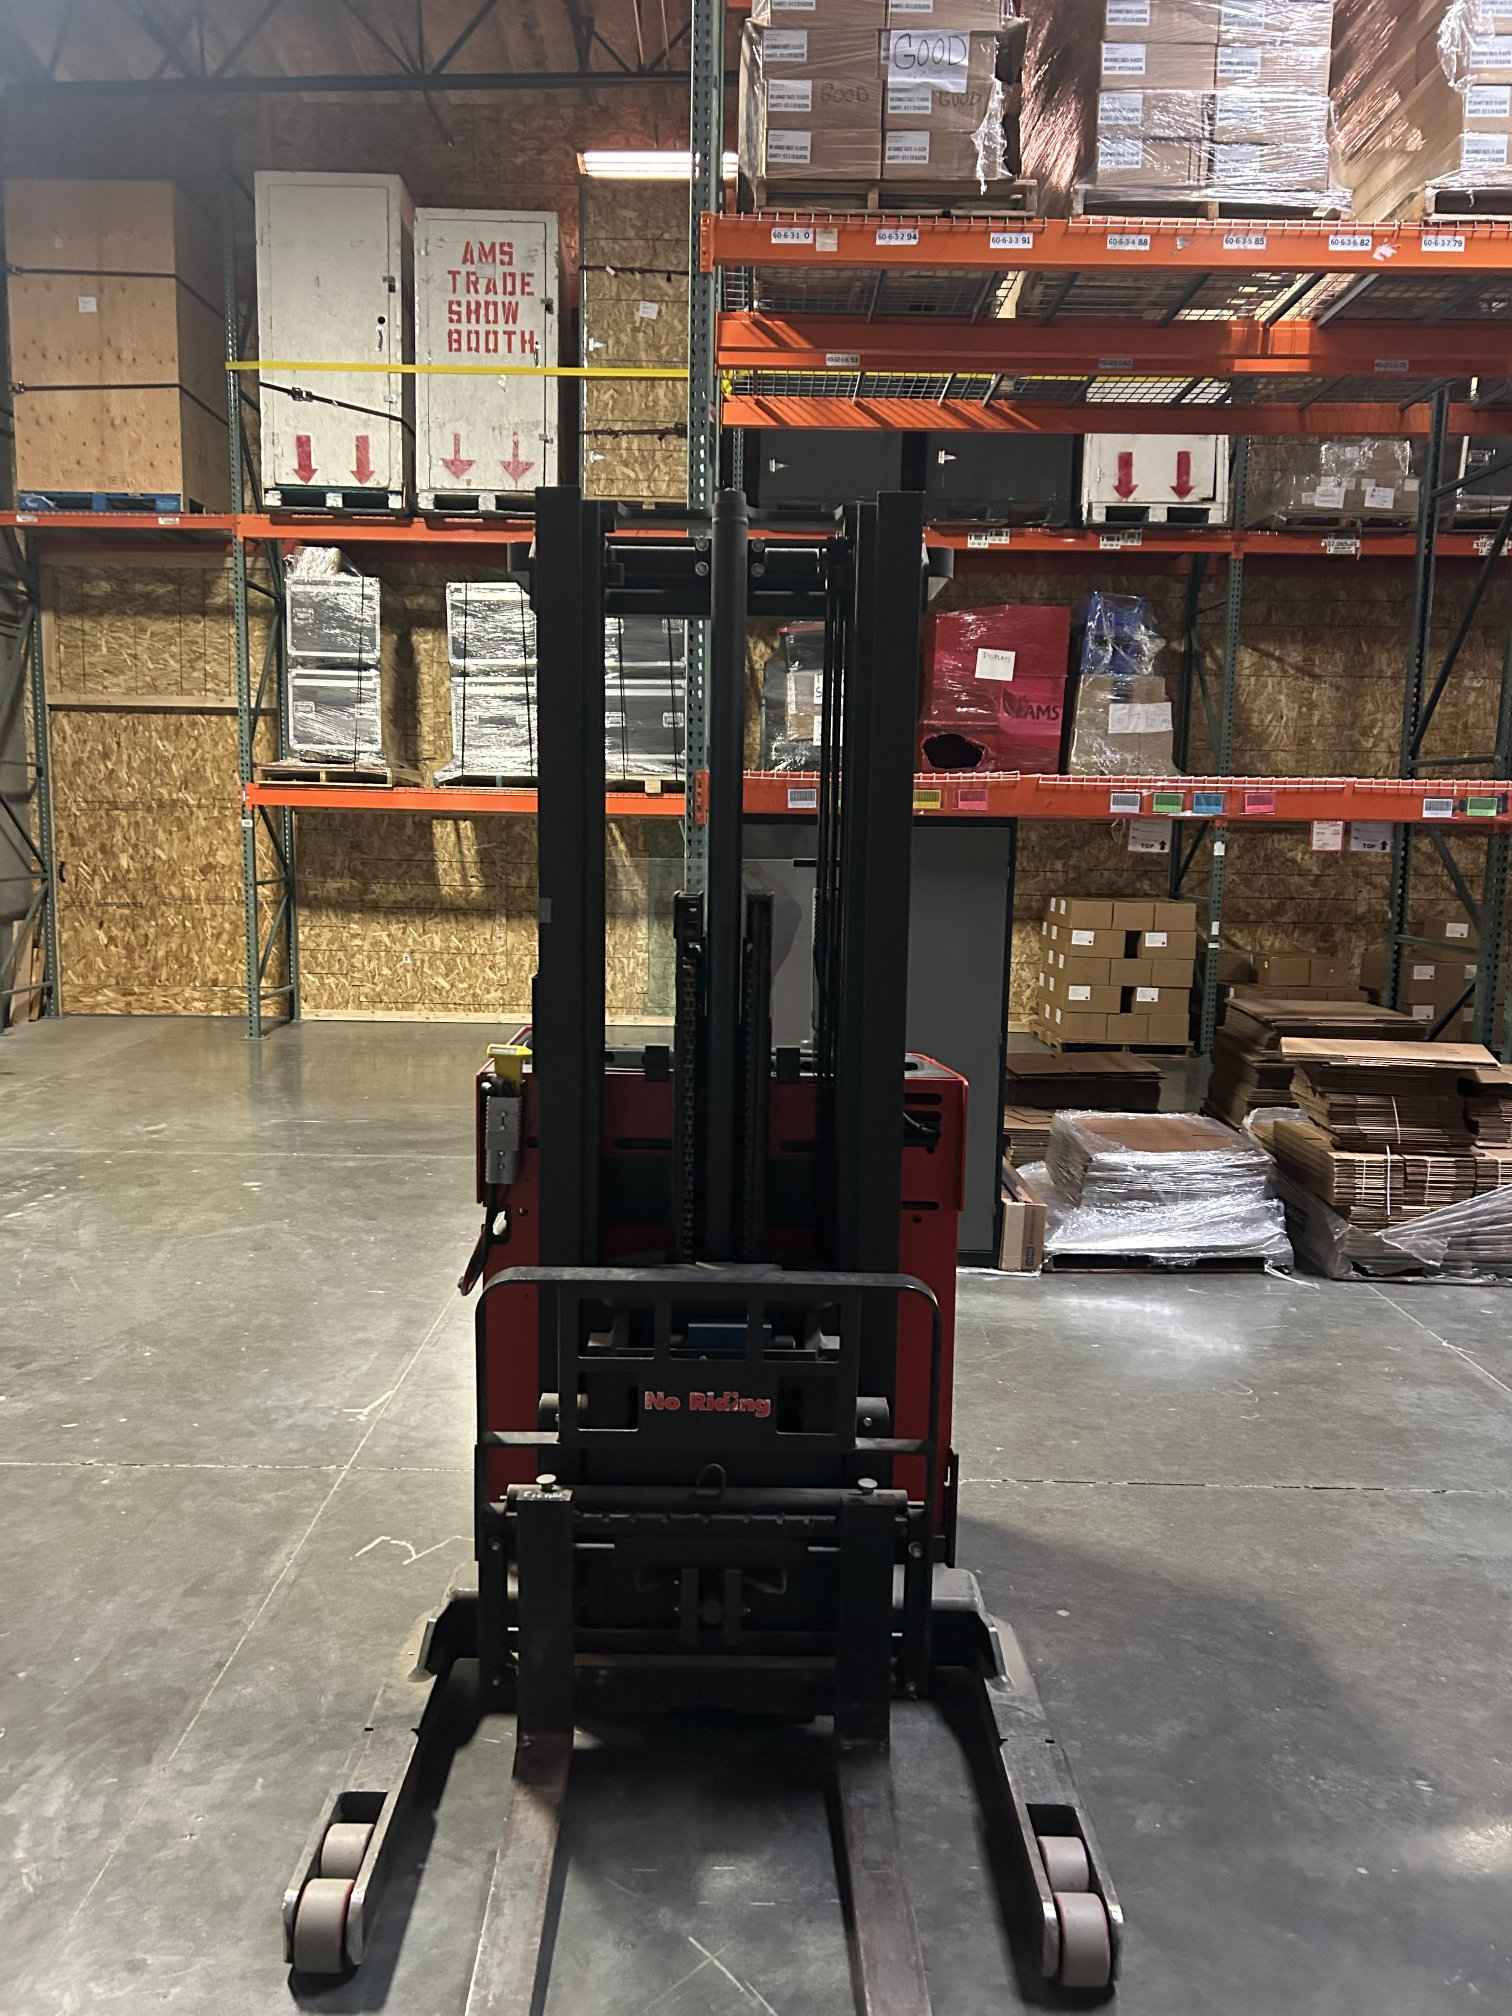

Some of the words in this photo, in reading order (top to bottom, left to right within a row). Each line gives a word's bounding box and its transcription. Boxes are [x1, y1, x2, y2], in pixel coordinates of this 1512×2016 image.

[894, 33, 967, 70] GOOD
[819, 83, 869, 104] GOOD
[462, 240, 514, 266] AMS
[447, 270, 535, 297] TRADE
[448, 299, 519, 325] SHOW
[447, 328, 536, 354] BOOTH
[1025, 704, 1060, 720] AMS
[644, 1391, 681, 1410] No
[689, 1391, 771, 1418] Riding
